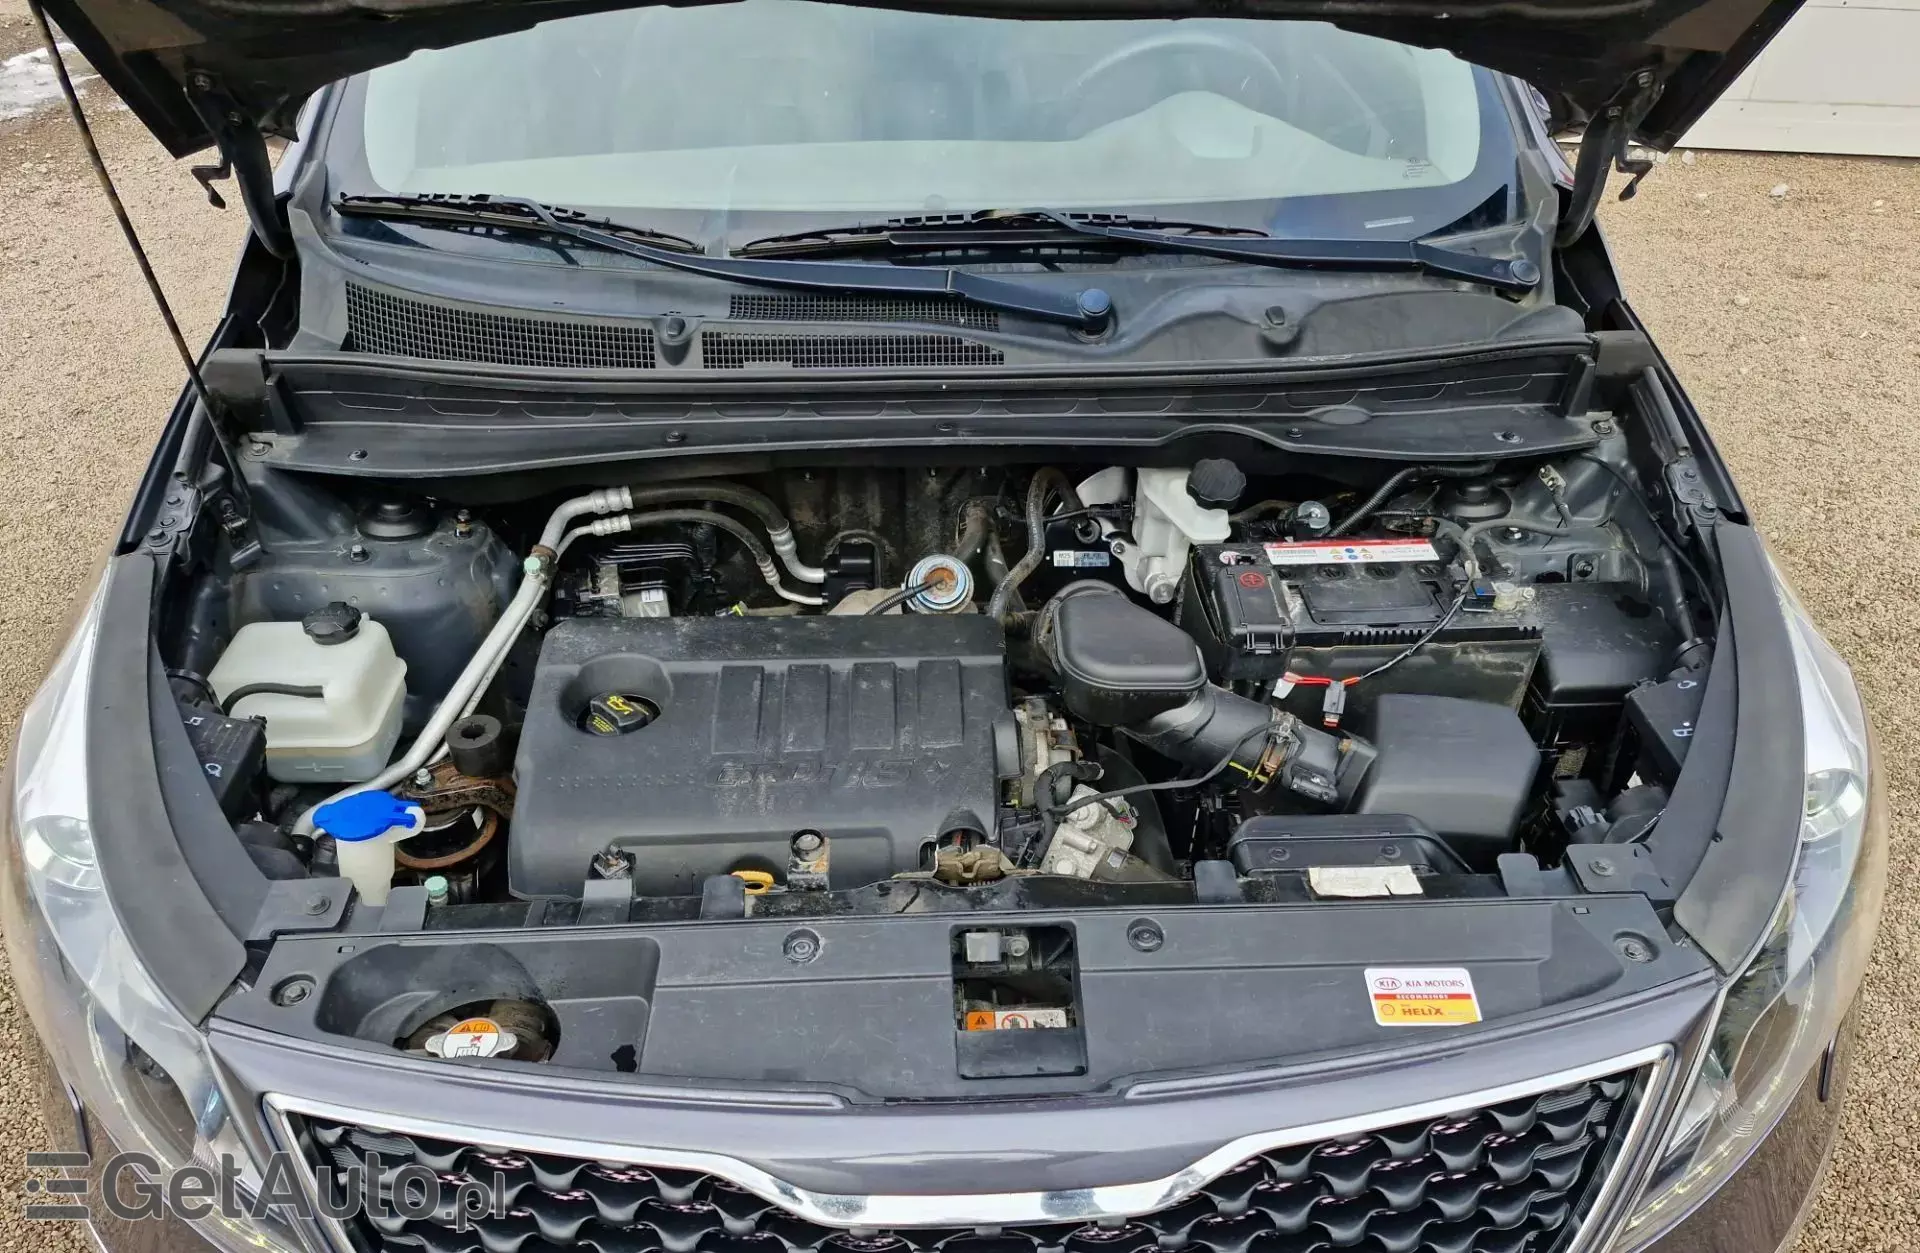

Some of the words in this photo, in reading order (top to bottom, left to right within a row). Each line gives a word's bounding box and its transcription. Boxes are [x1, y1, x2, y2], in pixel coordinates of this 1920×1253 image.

[1378, 980, 1397, 988] KIA
[1405, 980, 1421, 988] KIA
[1424, 980, 1465, 988] MOTORS
[1402, 1007, 1444, 1017] HELIX
